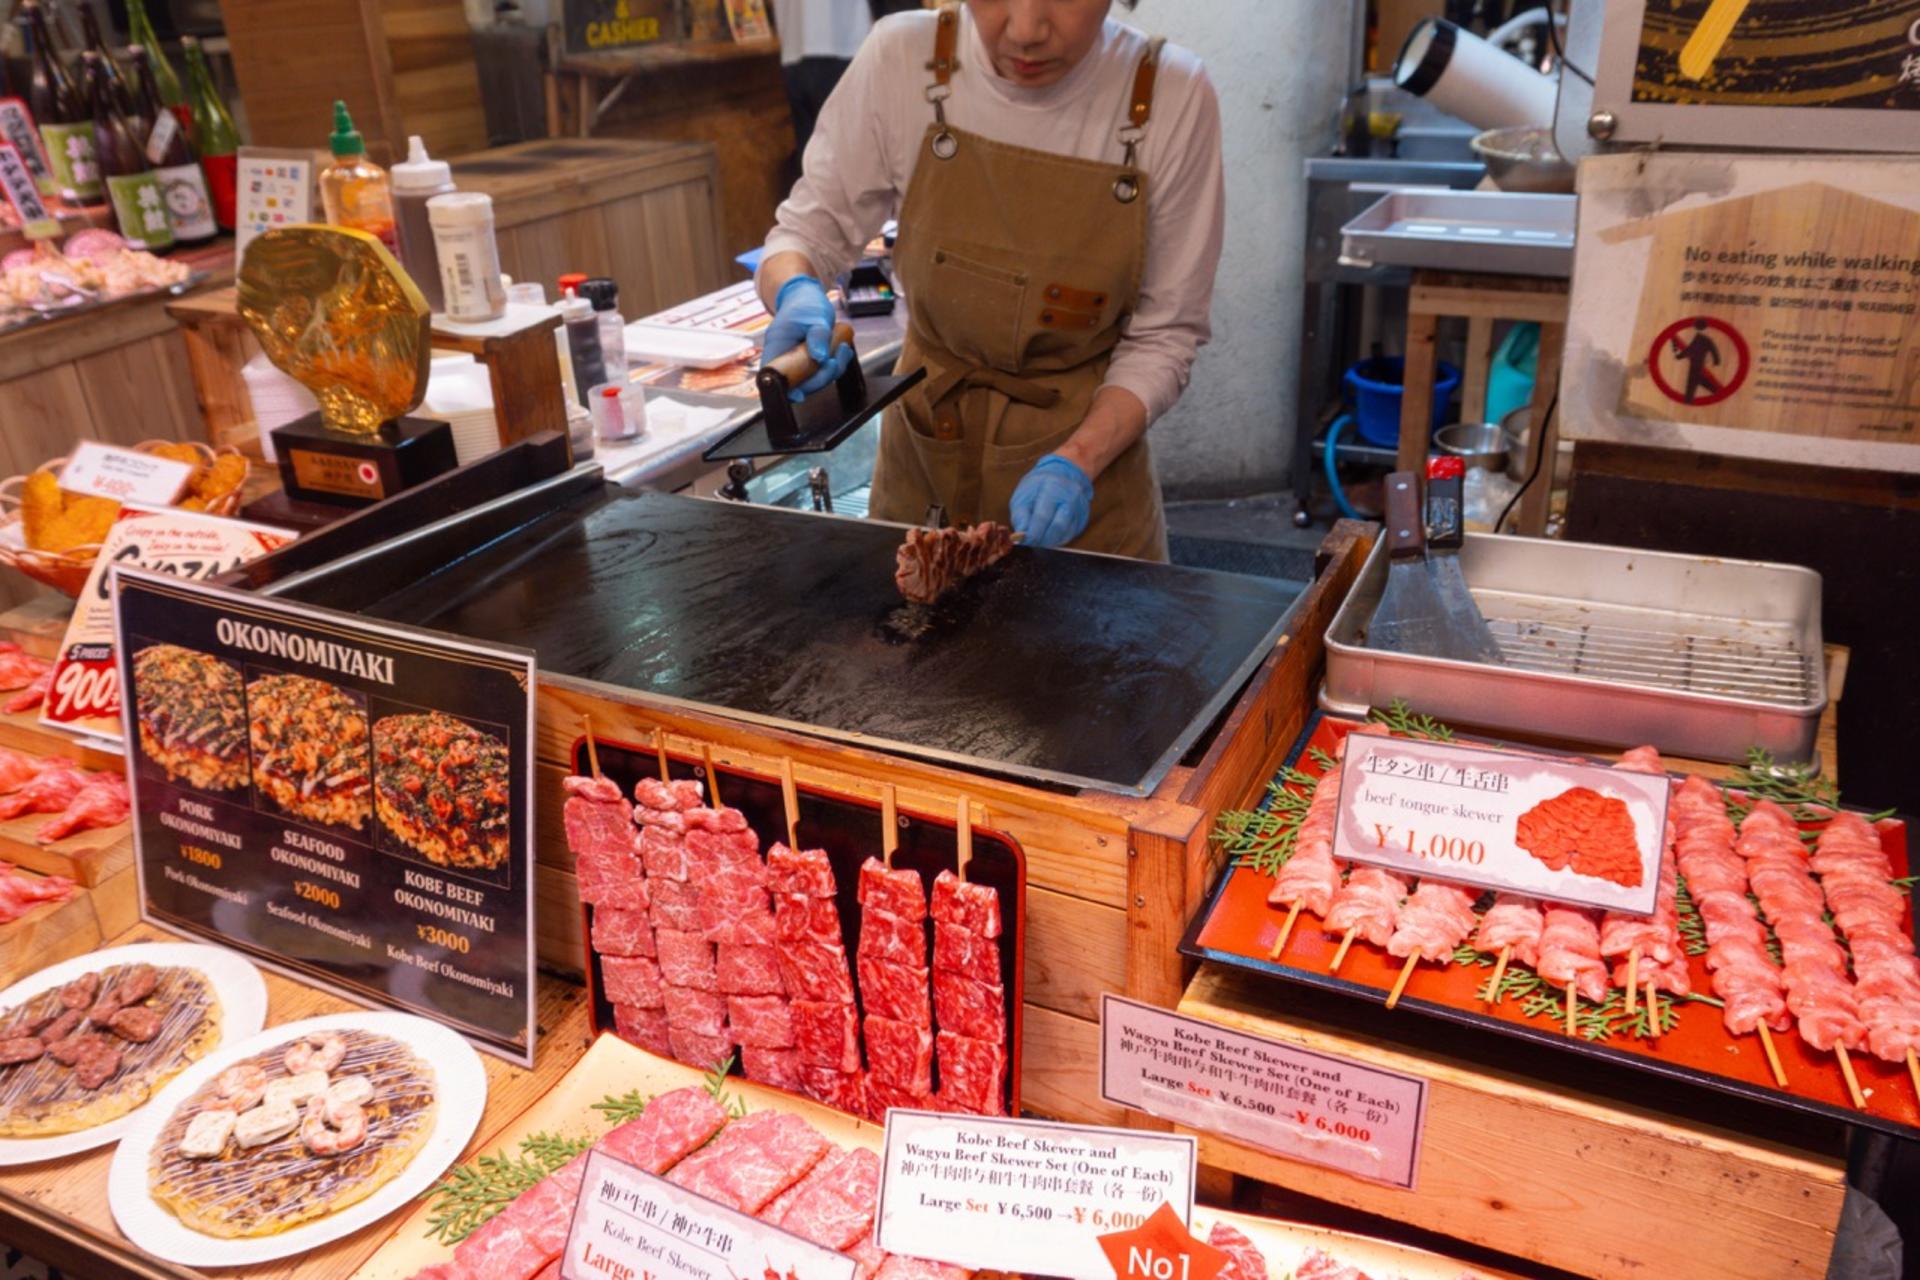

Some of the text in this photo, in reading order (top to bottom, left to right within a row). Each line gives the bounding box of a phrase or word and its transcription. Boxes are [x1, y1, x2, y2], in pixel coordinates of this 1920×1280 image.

[586, 17, 659, 48] CASHIER
[1685, 247, 1920, 275] No eating while walking
[216, 618, 394, 685] OKONOMIYAKI
[55, 662, 116, 716] 900
[1368, 755, 1435, 781] 牛タン串
[1456, 768, 1509, 792] 牛舌串
[179, 798, 215, 822] PORK
[1364, 788, 1504, 824] beef tongue skewer
[160, 811, 242, 850] OKONOMIYAKI
[284, 830, 346, 861] SEAFOOD
[1405, 829, 1486, 866] 1,000
[180, 845, 222, 870] ¥1800
[270, 847, 360, 889] OKONOMIYAKI
[164, 865, 248, 906] Pork Okonomiyaki
[294, 880, 341, 910] ¥2000
[404, 869, 484, 907] KOBE BEEF
[266, 901, 372, 949] Seafood Okonomiyaki
[394, 888, 495, 933] OKONOMIYAKI
[416, 924, 470, 954] ¥3000
[386, 944, 514, 999] Kobe Beef Okonomiyaki
[1122, 1025, 1400, 1114] Wagyu Beef Skewer Set (One of Each)
[1174, 1028, 1341, 1083] Kobe Beef Skewer and
[1141, 1068, 1184, 1090] Large
[1187, 1080, 1212, 1097] Set
[1233, 1096, 1276, 1117] 6,500
[1315, 1117, 1371, 1142] 6,000
[905, 1143, 1174, 1184] Wagyu Beef Skewer Set (One of Each)
[957, 1132, 1117, 1161] Kobe Beef Skewer and
[920, 1193, 961, 1212] Large
[965, 1198, 988, 1213] Set
[1012, 1202, 1053, 1221] 6,500
[1092, 1208, 1146, 1231] 6,000
[583, 1242, 635, 1280] Large
[603, 1219, 711, 1280] Kobe Beef Skewer
